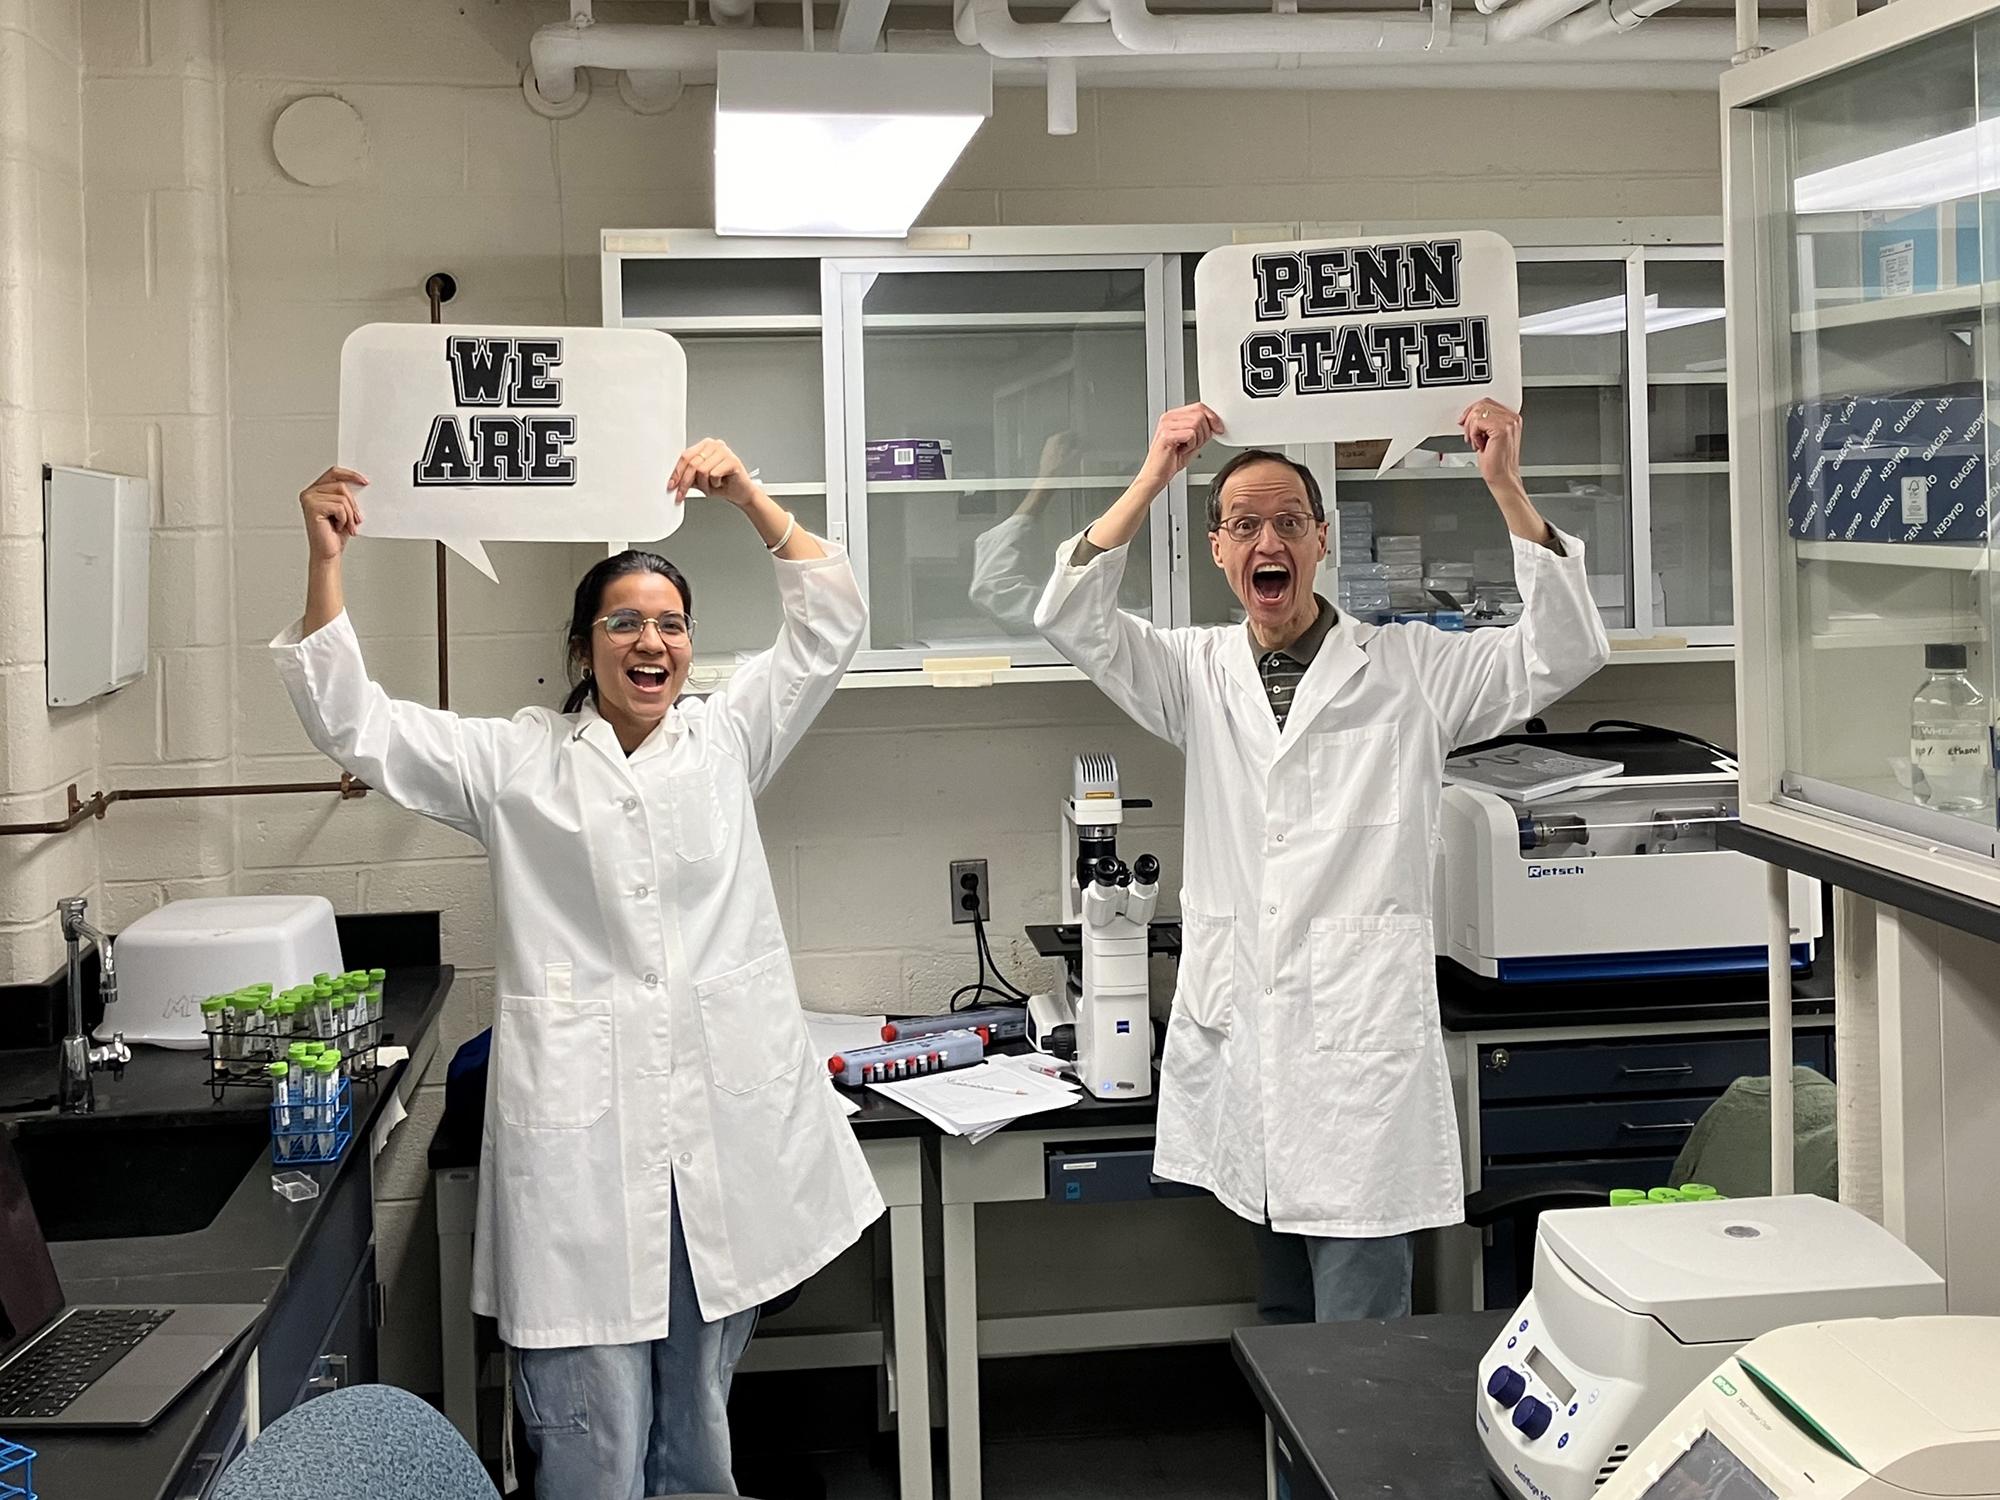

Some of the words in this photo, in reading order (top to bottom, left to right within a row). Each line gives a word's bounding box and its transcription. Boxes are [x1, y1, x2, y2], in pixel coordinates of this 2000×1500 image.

[1253, 239, 1461, 321] PENN
[447, 336, 563, 407] WE
[1241, 316, 1492, 398] STATE!
[1894, 399, 1925, 433] QIAGEN
[413, 414, 577, 487] ARE
[1792, 428, 1809, 461] QIAGEN
[1861, 417, 1882, 452] QIAGEN
[1922, 426, 1953, 461] QIAGEN
[1832, 436, 1853, 470] QIAGEN
[1880, 446, 1909, 482] QIAGEN
[1807, 455, 1825, 488] QIAGEN
[1851, 465, 1873, 499] QIAGEN
[1950, 453, 1980, 489] QIAGEN
[1800, 501, 1819, 533] QIAGEN
[1824, 483, 1843, 517] QIAGEN
[1870, 494, 1894, 528] QIAGEN
[1933, 502, 1964, 538] QIAGEN
[1528, 865, 1584, 878] Retsch
